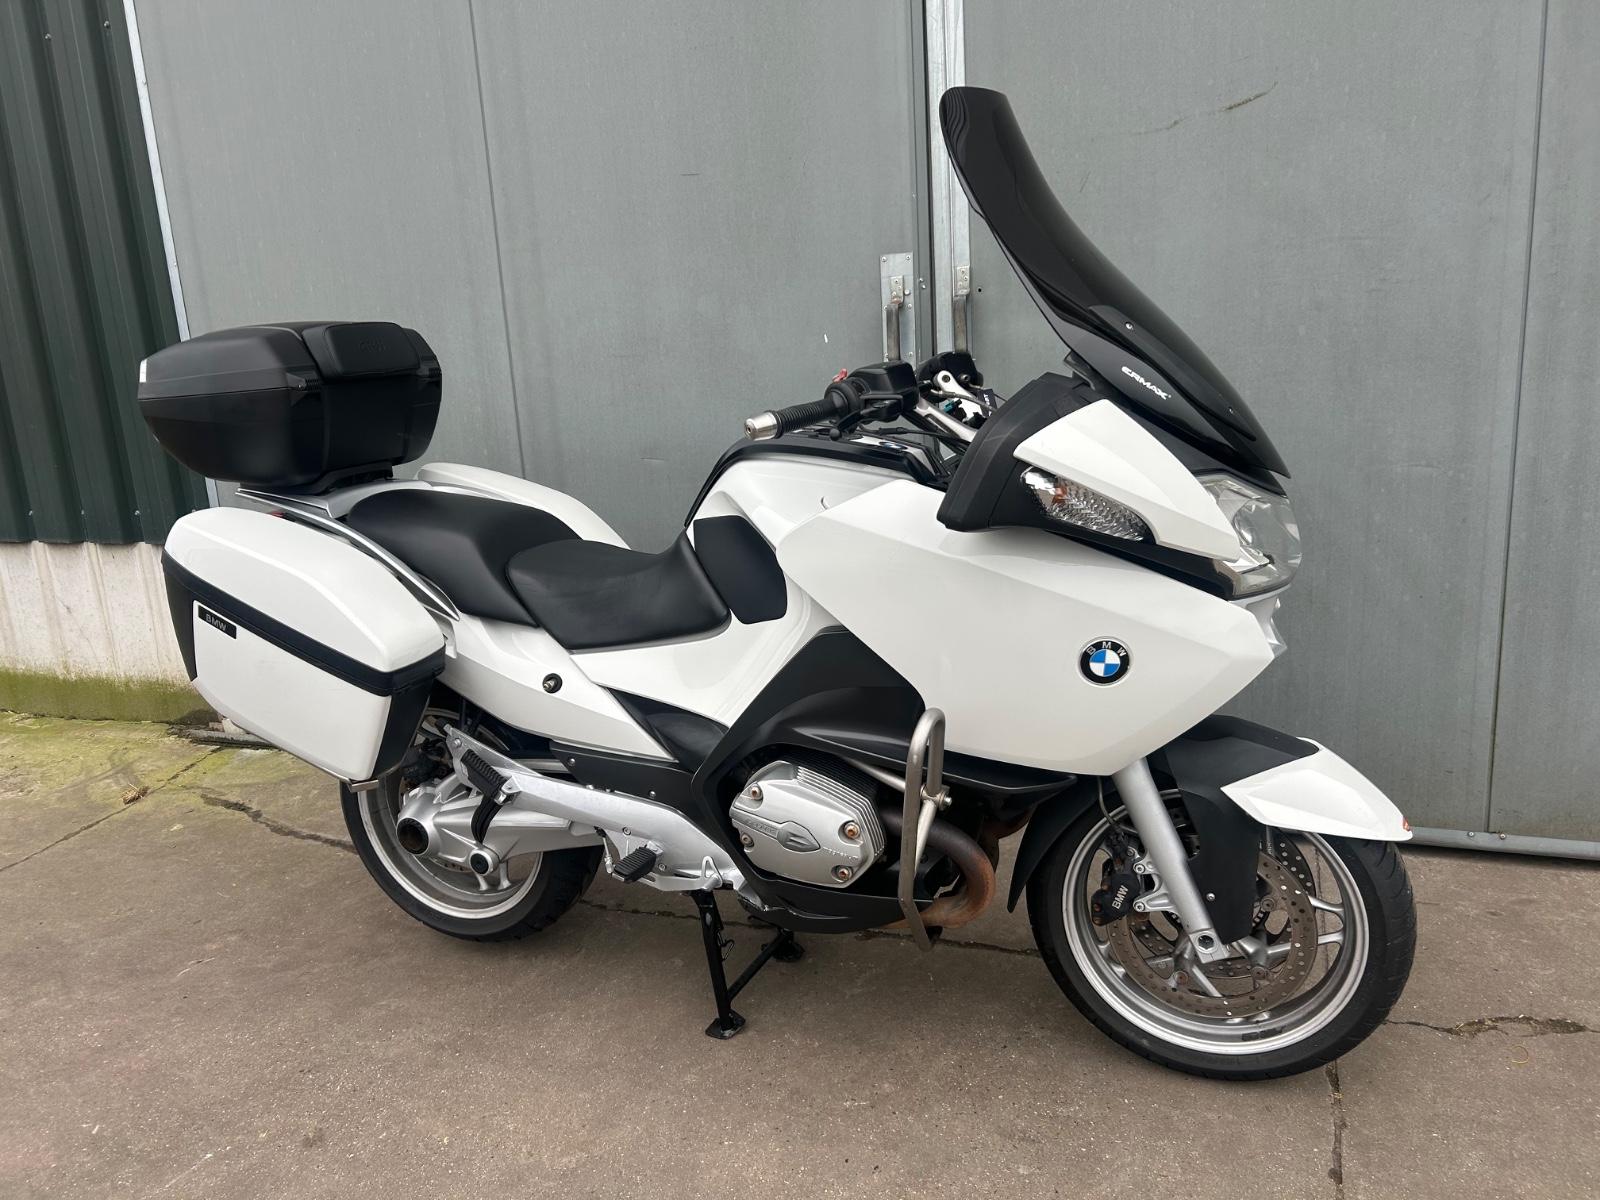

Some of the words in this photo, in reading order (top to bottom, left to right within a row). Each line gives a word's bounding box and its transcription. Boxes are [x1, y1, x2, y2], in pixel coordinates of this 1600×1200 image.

[1121, 366, 1168, 400] ERMAX
[205, 613, 227, 631] BMW
[1086, 641, 1127, 657] BMW
[1111, 884, 1129, 910] BMW
